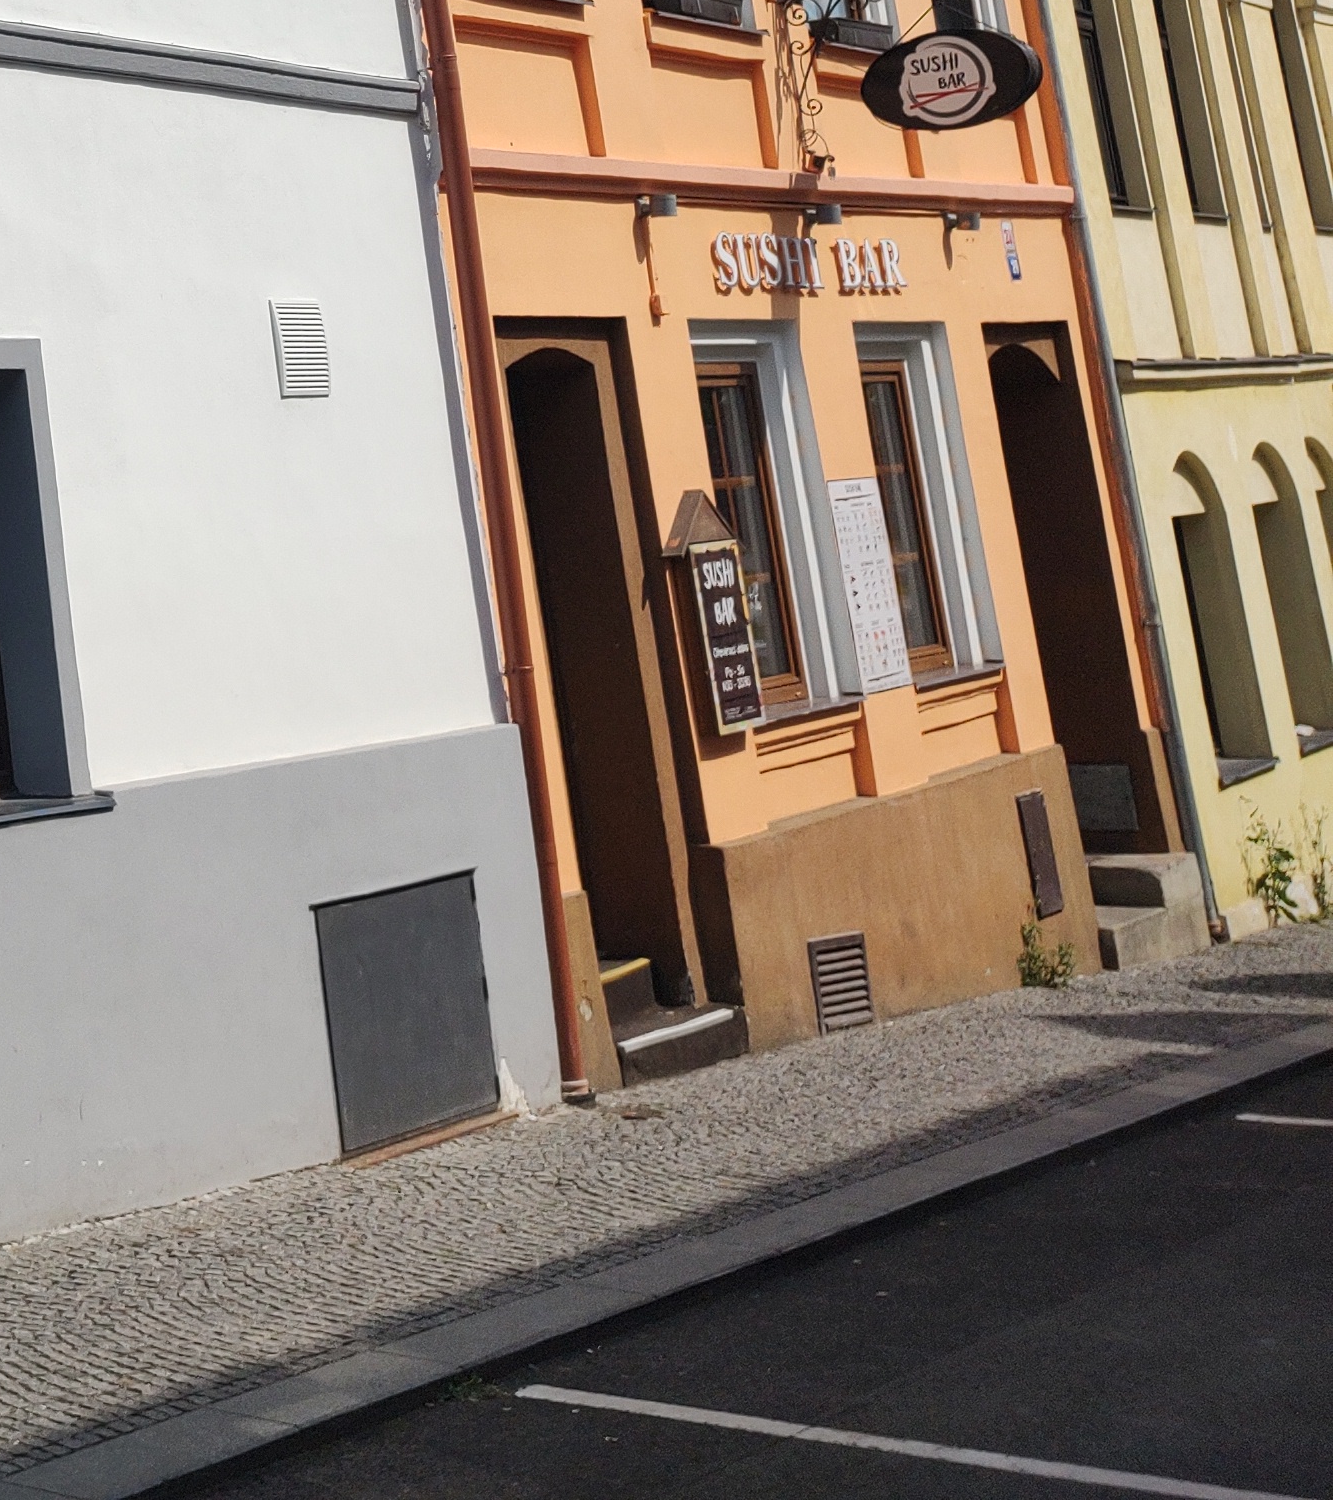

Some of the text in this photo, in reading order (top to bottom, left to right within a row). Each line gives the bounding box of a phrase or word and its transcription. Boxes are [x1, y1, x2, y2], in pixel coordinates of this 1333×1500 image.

[910, 52, 959, 75] SUSHI
[938, 72, 967, 89] BAR
[715, 231, 907, 289] SUSHI BAR
[702, 558, 735, 590] SUSHI
[714, 597, 737, 627] BAR
